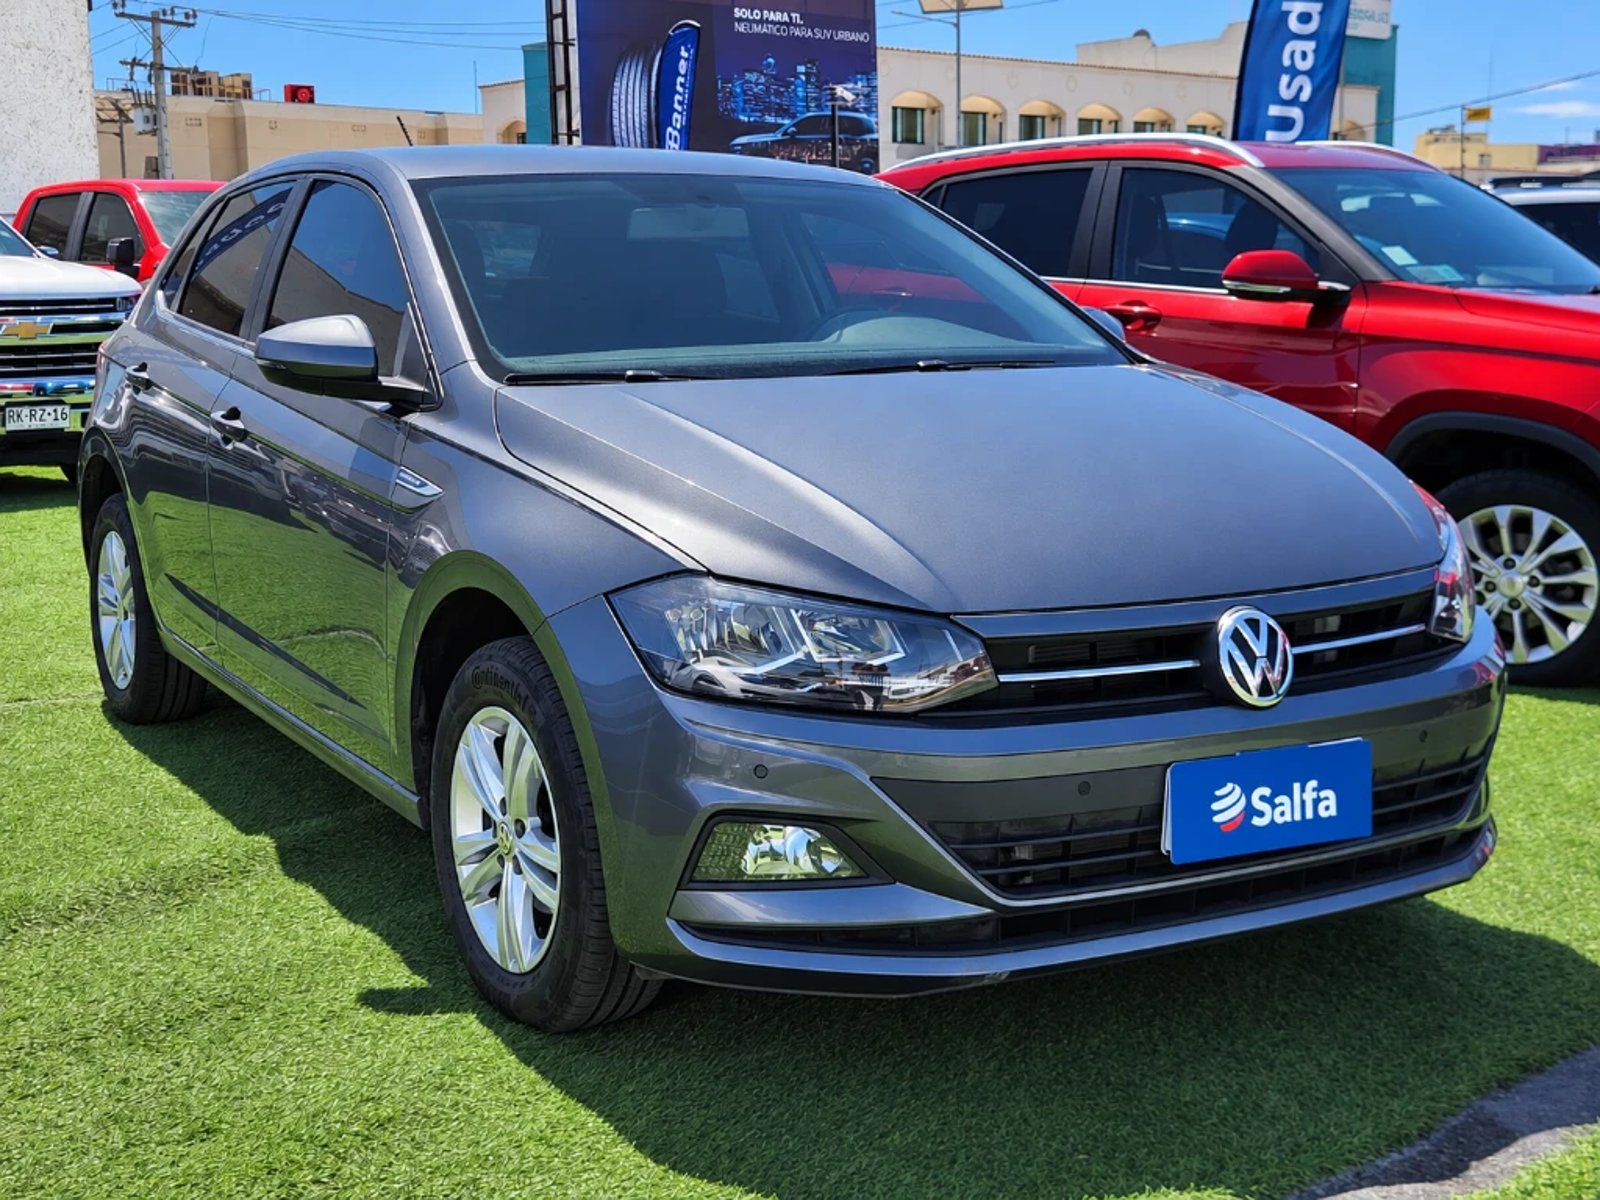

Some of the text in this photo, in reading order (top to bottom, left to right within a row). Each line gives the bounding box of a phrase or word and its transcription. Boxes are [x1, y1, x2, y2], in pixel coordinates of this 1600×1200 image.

[734, 7, 803, 24] SOLO PARA TI.
[789, 26, 813, 39] PARA
[813, 27, 832, 40] SUV
[832, 29, 870, 43] URBANO
[665, 45, 689, 150] Banner
[1251, 779, 1337, 828] Salfa
